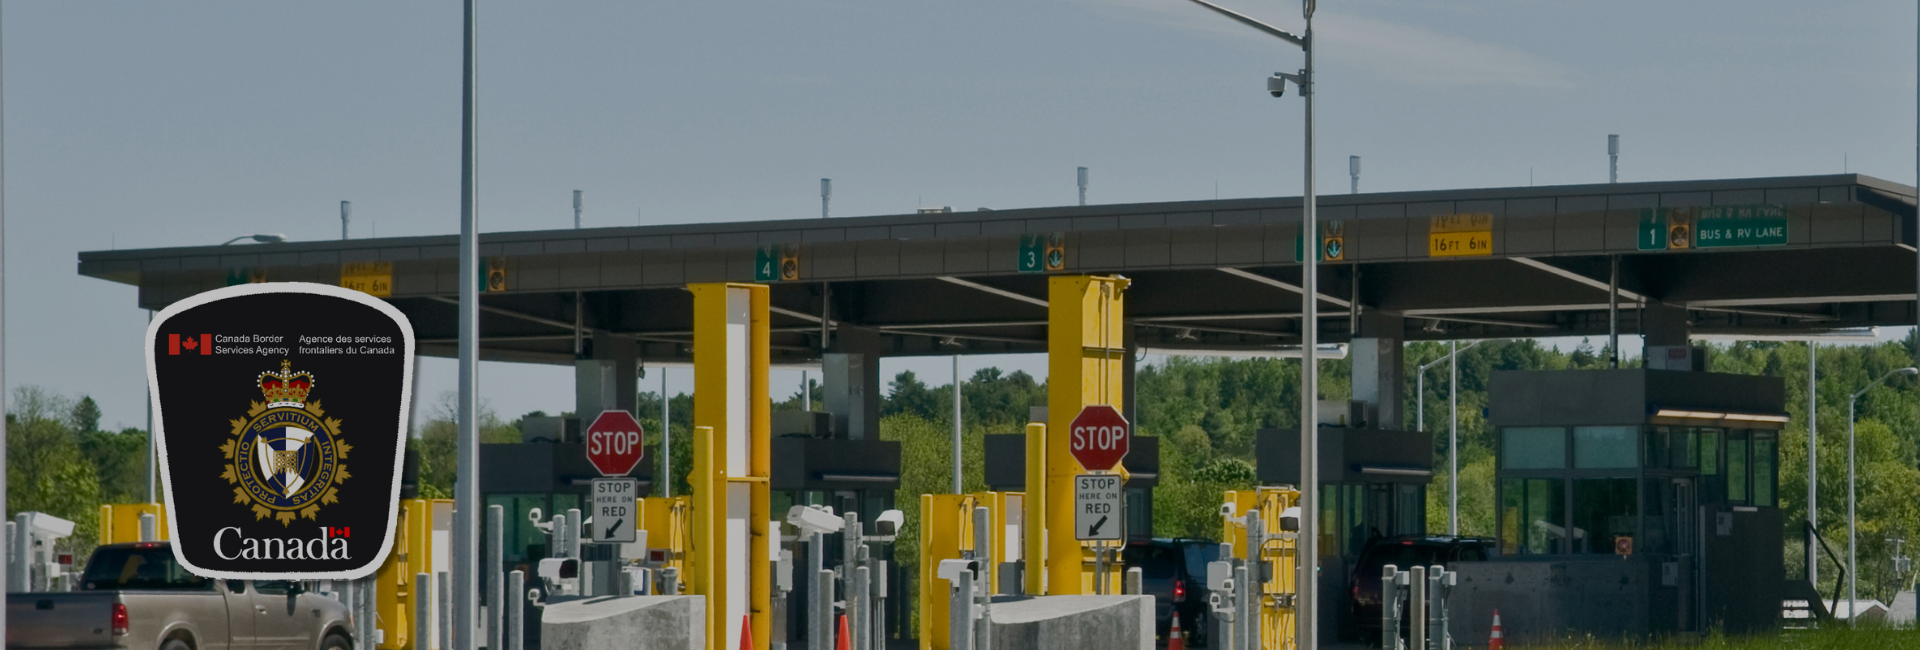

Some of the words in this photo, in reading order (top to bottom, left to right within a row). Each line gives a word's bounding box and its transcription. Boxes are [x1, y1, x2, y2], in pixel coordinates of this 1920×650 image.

[1650, 228, 1656, 245] 1
[1700, 229, 1720, 240] BUS
[1725, 228, 1732, 239] &
[1737, 227, 1751, 239] RV
[1756, 226, 1783, 238] LANE
[1469, 236, 1487, 250] 6IN
[1026, 251, 1036, 268] 3
[762, 261, 771, 278] 4
[372, 280, 388, 292] 6IN
[591, 431, 639, 455] STOP
[1073, 426, 1125, 451] STOP
[598, 482, 631, 493] STOP
[1081, 478, 1115, 490] STOP
[1079, 492, 1102, 500] HERE
[1105, 492, 1118, 500] ON
[602, 506, 627, 517] RED
[1085, 503, 1111, 514] RED
